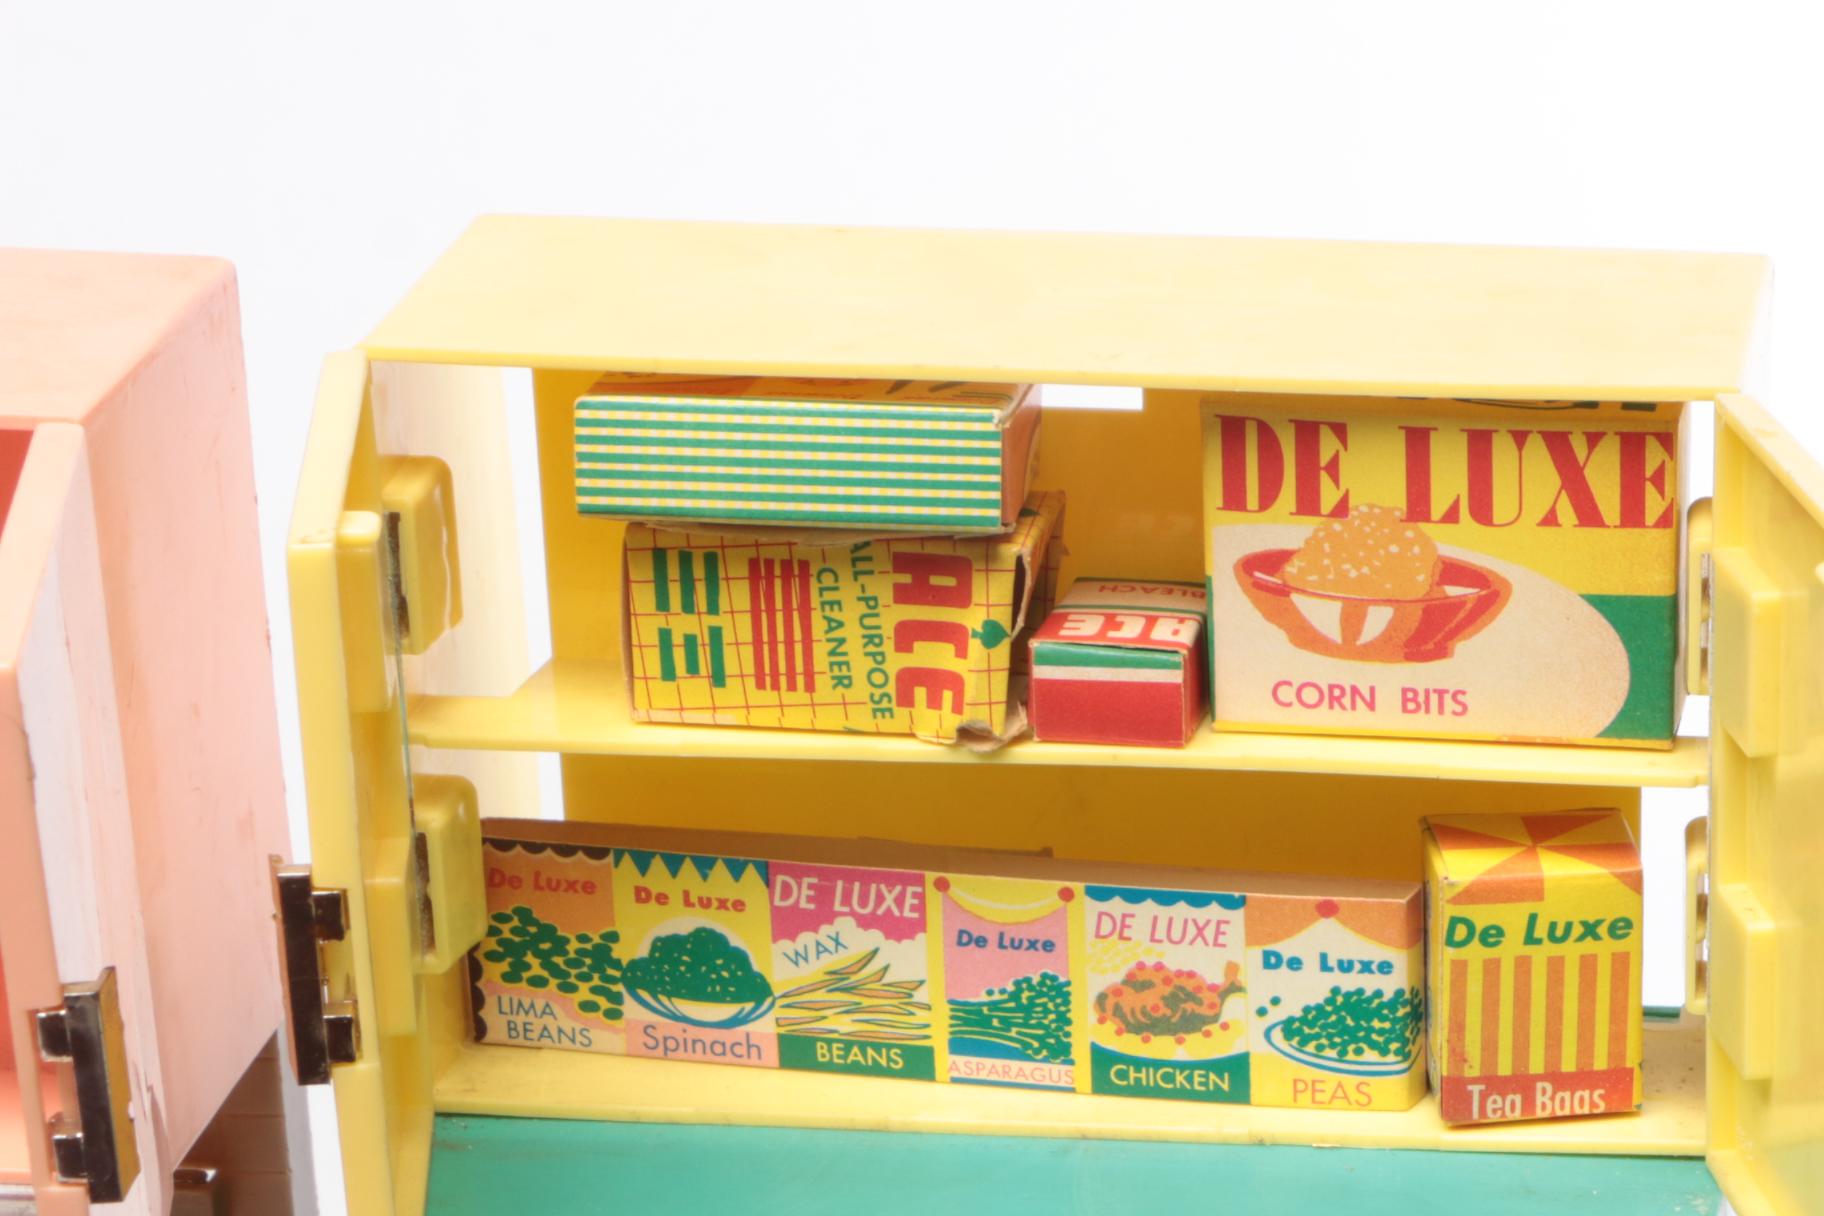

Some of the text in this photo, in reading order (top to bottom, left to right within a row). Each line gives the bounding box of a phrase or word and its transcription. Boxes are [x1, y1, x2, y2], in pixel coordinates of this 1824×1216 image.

[1215, 414, 1674, 529] DE LUXE
[816, 567, 853, 691] CLEANER
[892, 551, 973, 716] ACE
[1058, 613, 1200, 648] ACE
[1271, 680, 1470, 718] CORN BITS
[488, 867, 597, 896] De Luxe
[634, 885, 747, 913] De Luxe
[774, 875, 924, 919] DE LUXE
[956, 929, 1056, 954] De Luxe
[1094, 911, 1231, 949] DE LUXE
[1444, 912, 1634, 949] De Luxe
[782, 931, 849, 968] WAX
[1262, 949, 1394, 976] De Luxe
[497, 995, 557, 1020] LIMA
[507, 1020, 593, 1048] BEANS
[643, 1025, 763, 1062] Spinach
[816, 1042, 905, 1070] BEANS
[948, 1059, 1075, 1086] ASPARAGUS
[1109, 1063, 1231, 1093] CHICKEN
[1292, 1078, 1373, 1107] PEAS
[1466, 1084, 1522, 1120] Tea
